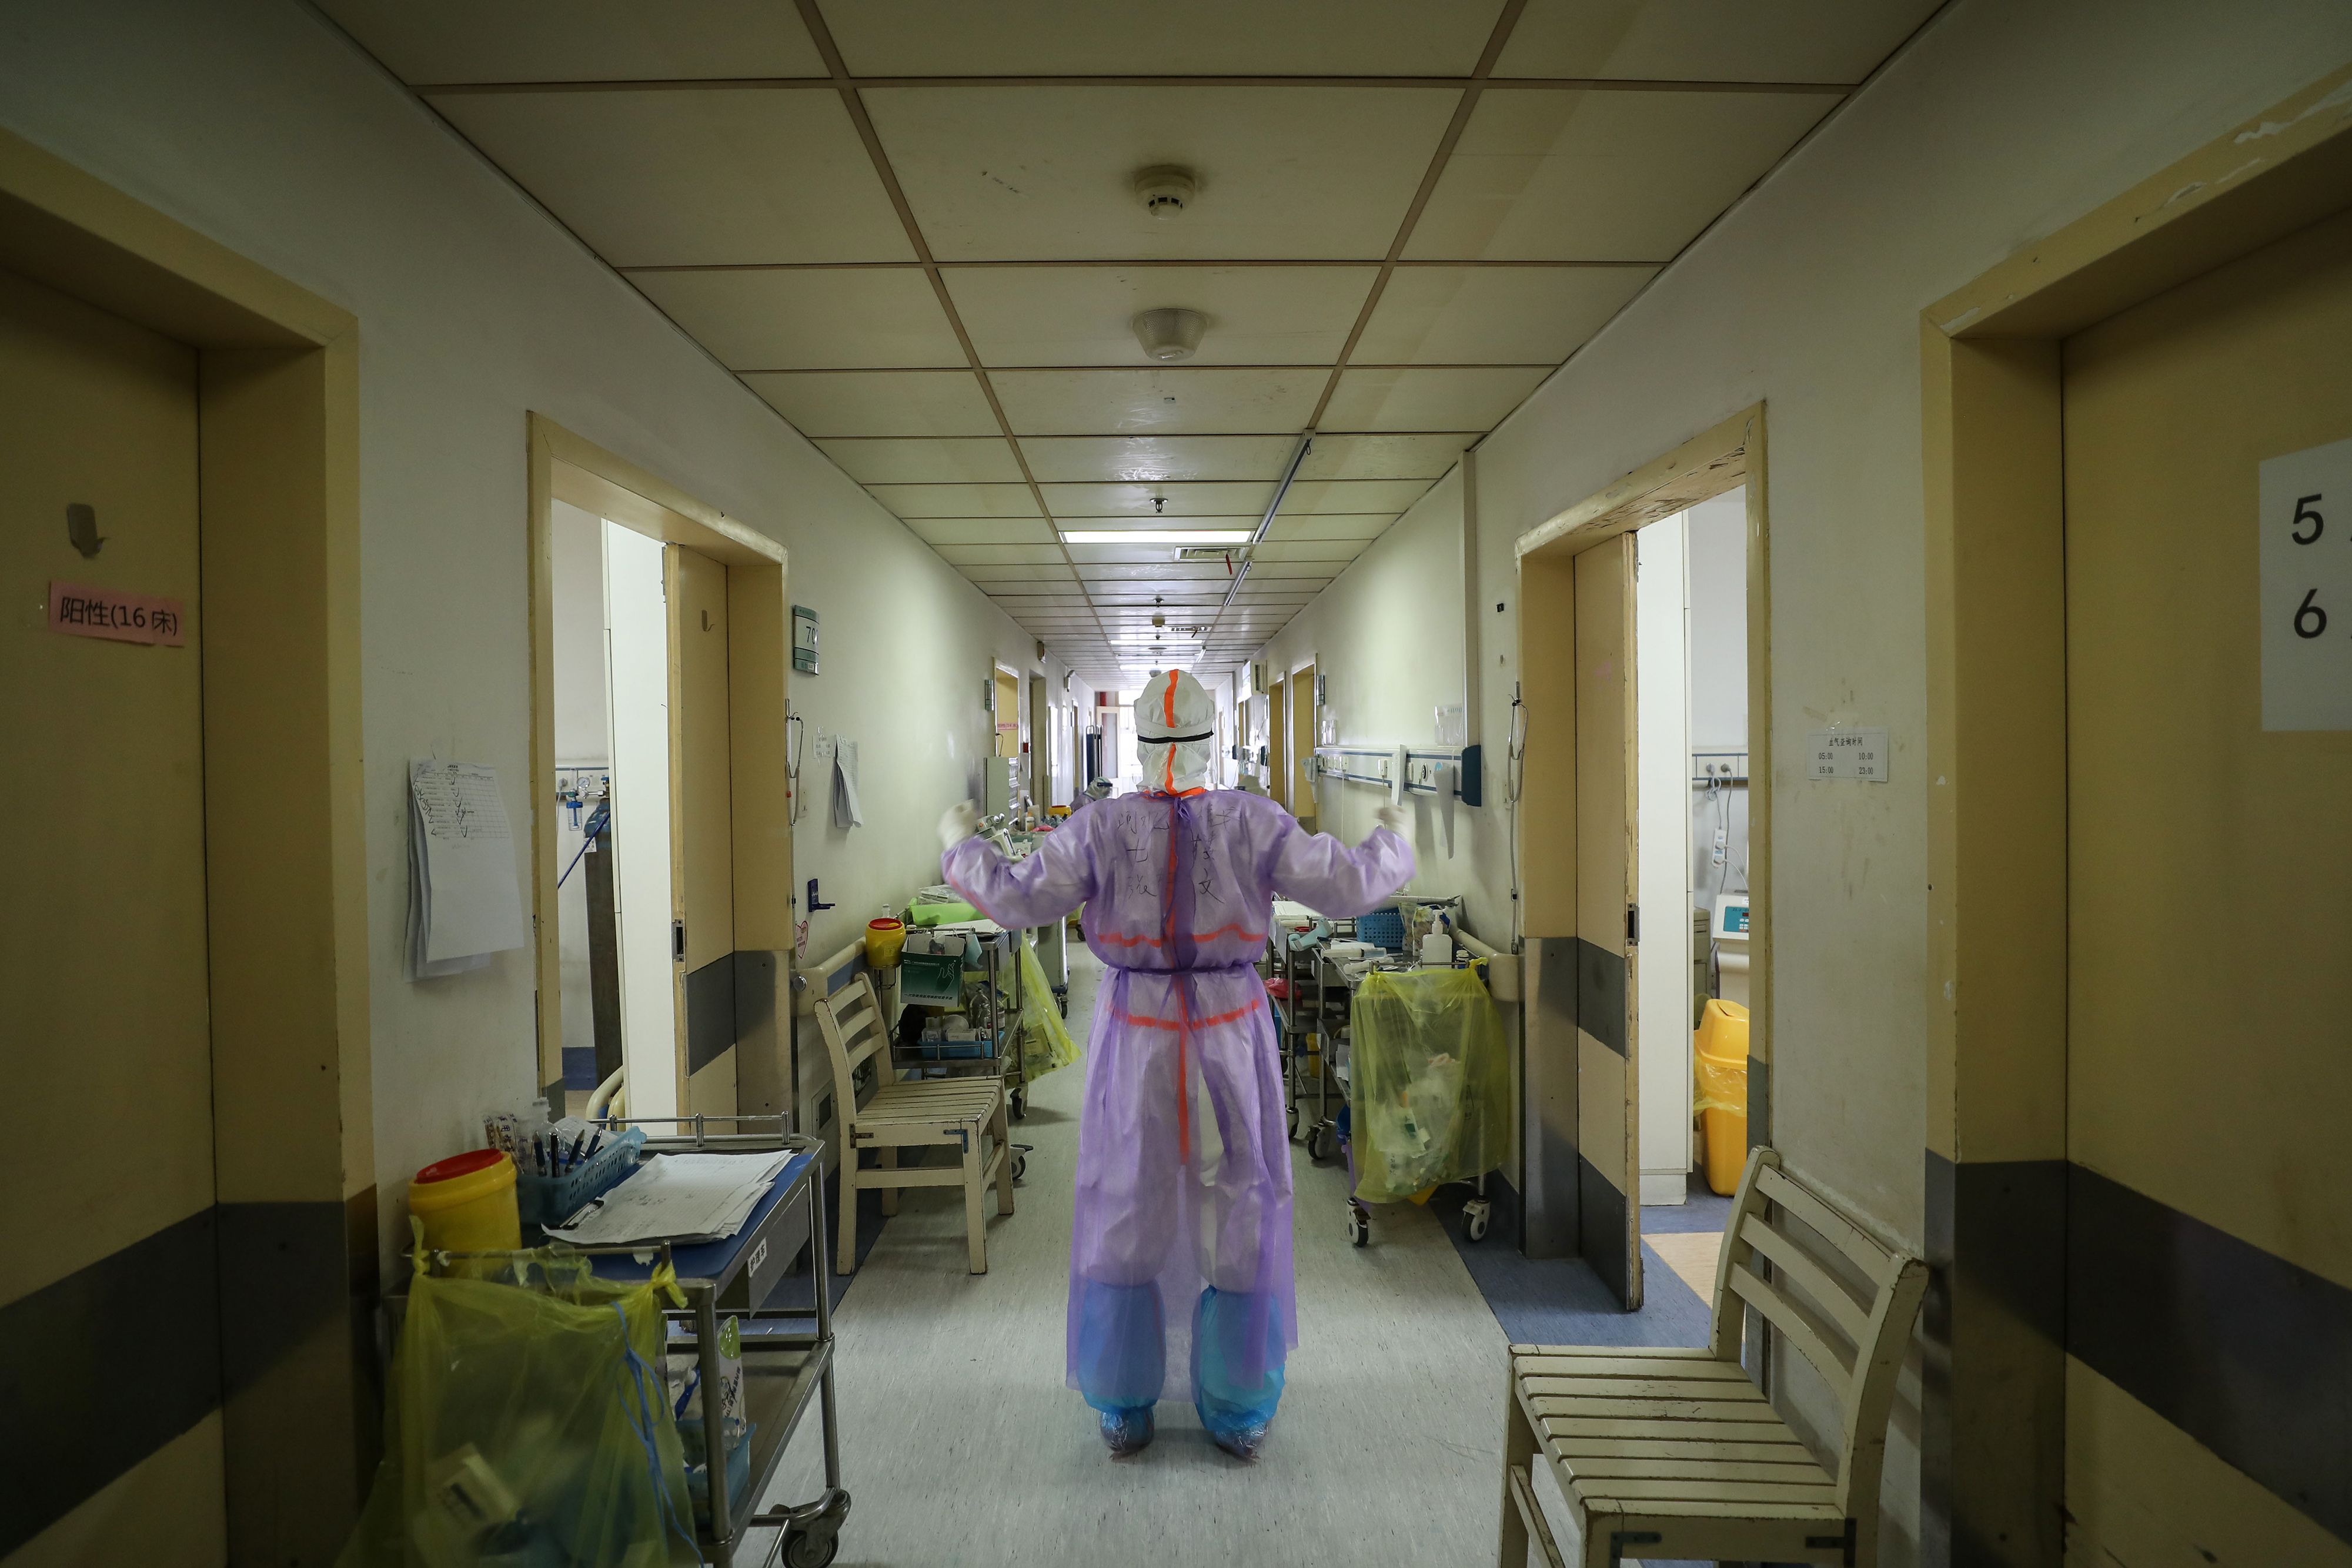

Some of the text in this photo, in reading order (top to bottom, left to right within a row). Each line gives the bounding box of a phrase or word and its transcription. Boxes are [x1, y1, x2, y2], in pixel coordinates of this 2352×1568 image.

[2291, 493, 2324, 546] 5
[60, 596, 177, 636] 阳性(16床)
[2293, 588, 2327, 639] 6
[1818, 752, 1873, 760] 05:00 10:00
[1859, 767, 1873, 775] 23:00
